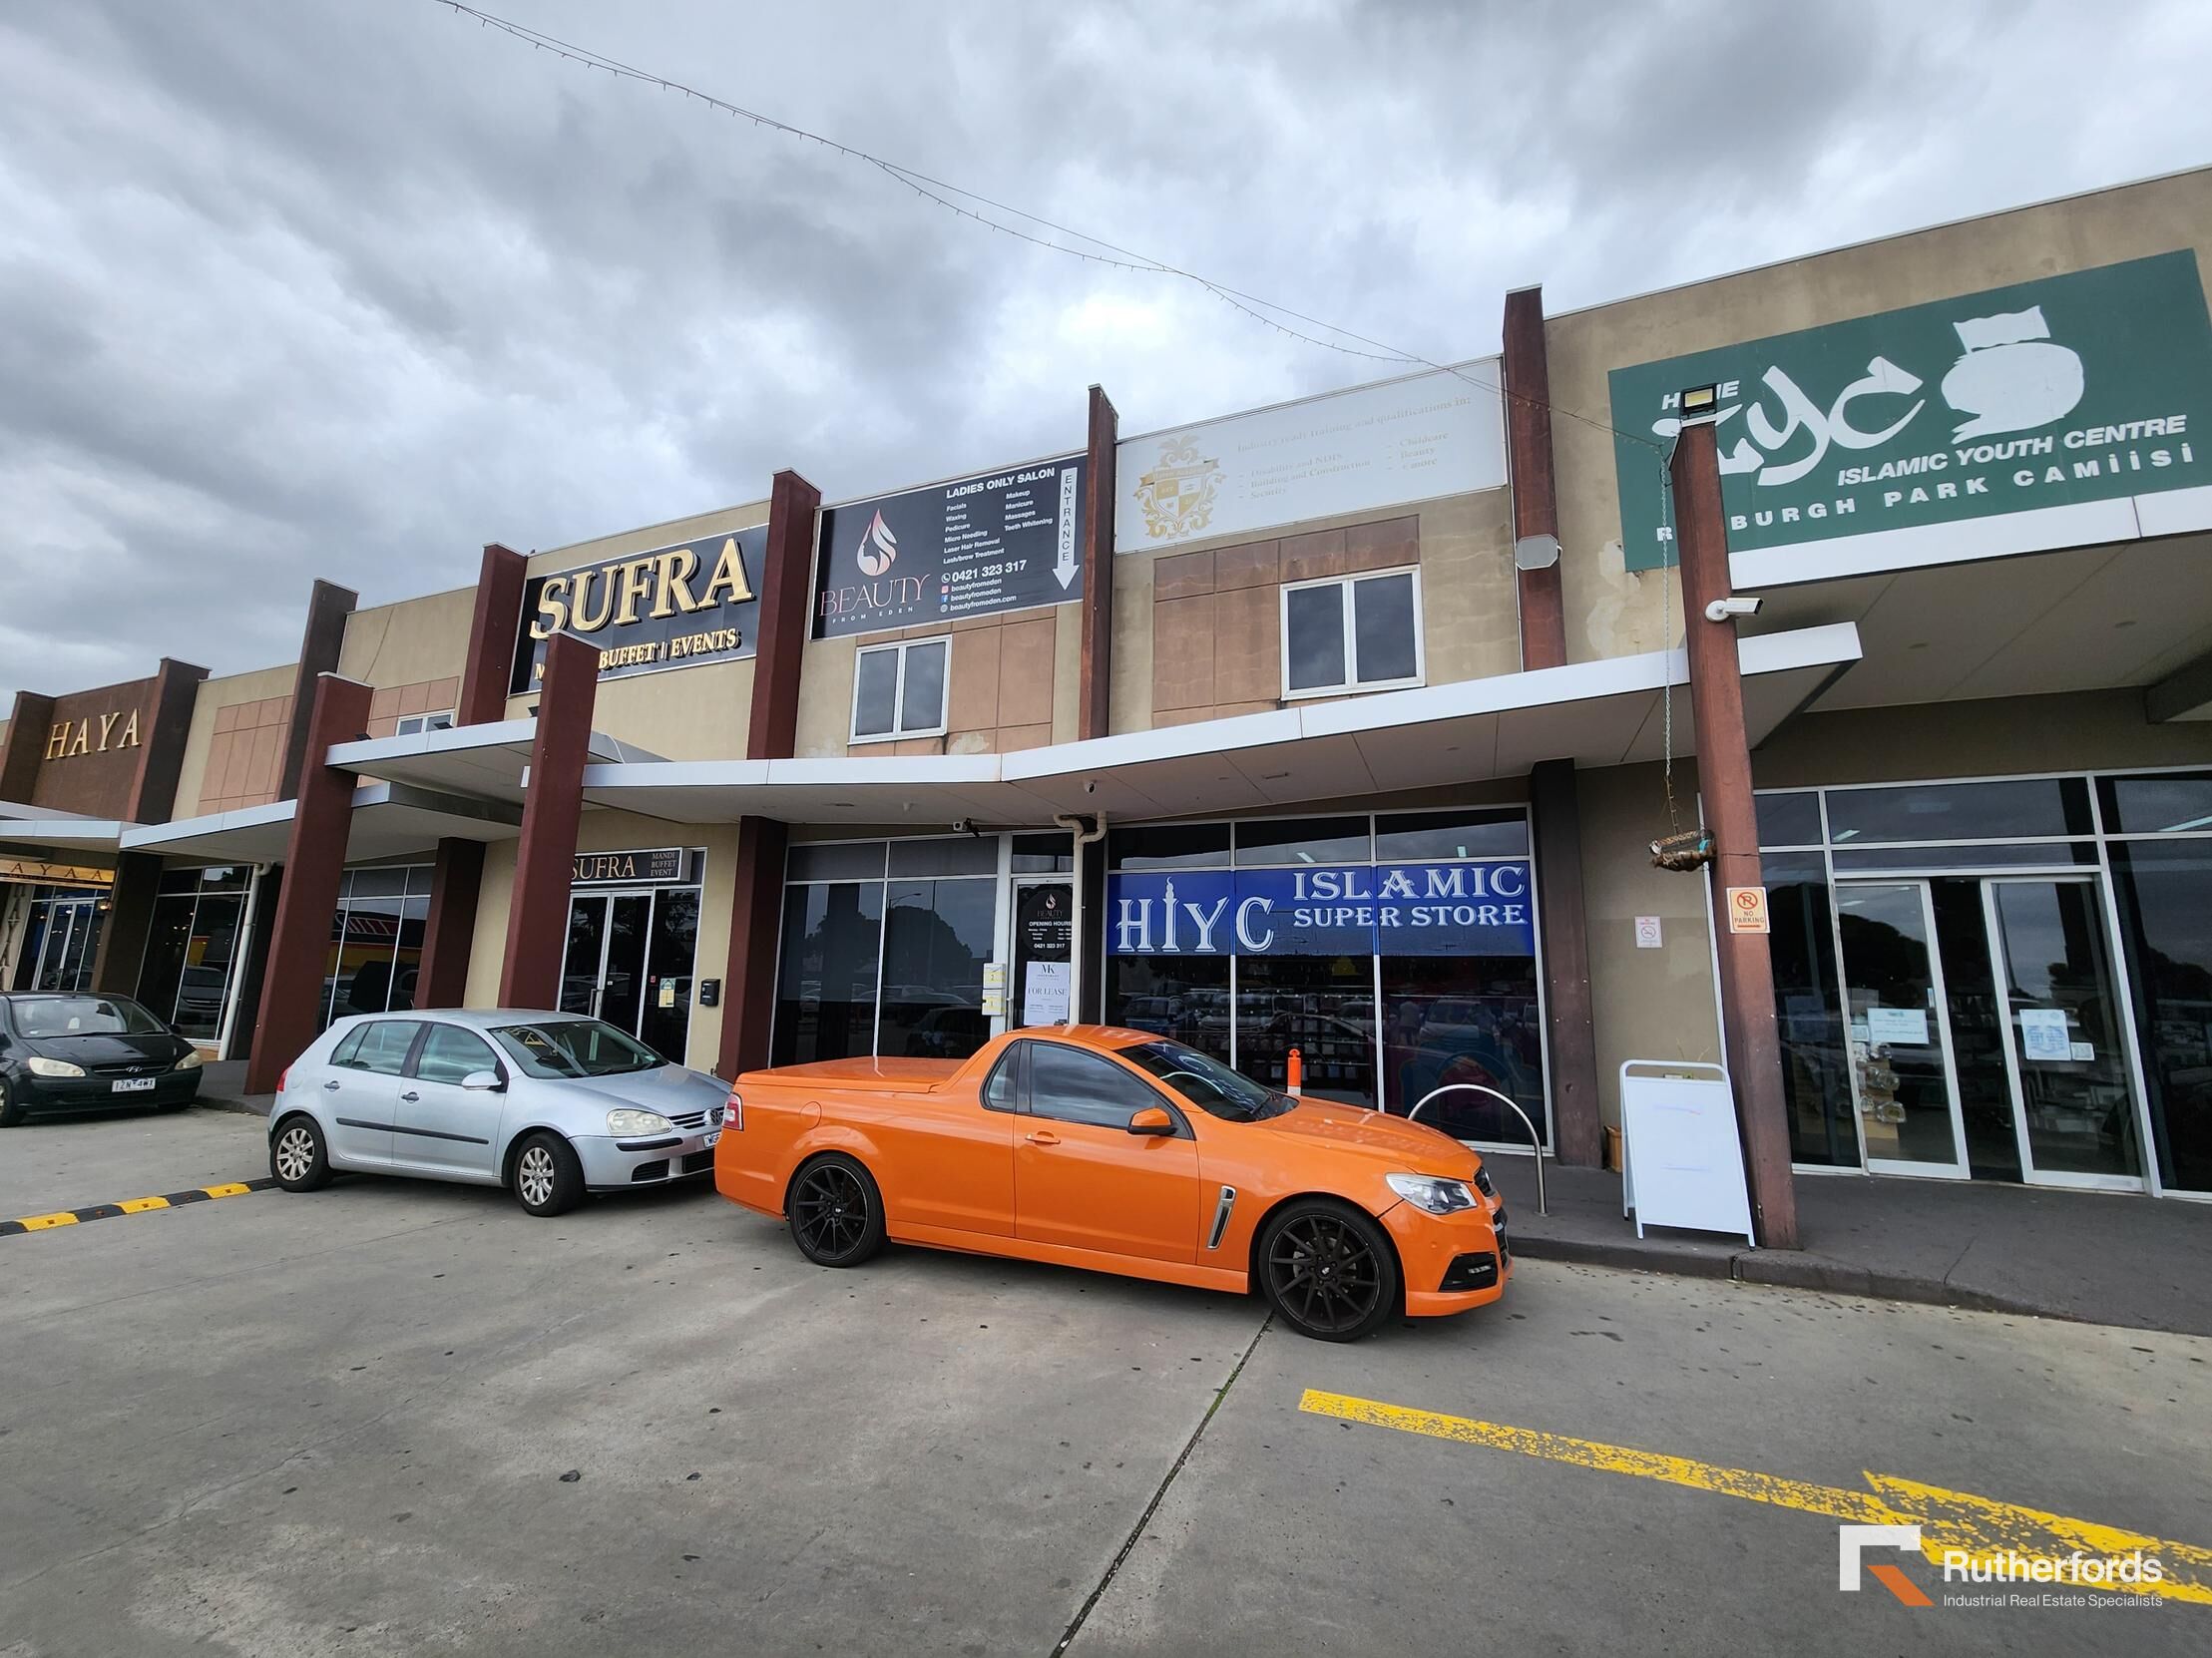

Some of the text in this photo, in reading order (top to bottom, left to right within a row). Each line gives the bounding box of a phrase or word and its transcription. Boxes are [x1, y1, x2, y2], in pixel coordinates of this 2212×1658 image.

[1661, 380, 1740, 410] HE
[1377, 401, 1453, 424] qualifications
[1400, 447, 1435, 459] Beauty
[1837, 415, 2187, 487] ISLAMIC YOUTH CENTRE
[1250, 460, 1371, 489] Building and Construction
[946, 467, 1056, 499] LADIES ONLY SALON
[1006, 490, 1031, 499] Makeup
[1250, 487, 1286, 499] Security
[946, 503, 967, 512] Facials
[1005, 500, 1034, 510] Manicure
[1656, 498, 1855, 542] RBURGH
[1884, 477, 1989, 508] PARK
[946, 514, 967, 523] Waxing
[1005, 511, 1036, 521] Massages
[1062, 475, 1073, 562] ENTRANCE
[945, 523, 971, 533] Pedicure
[1004, 518, 1054, 532] Teeth Whitening
[962, 530, 988, 541] Needling
[961, 542, 973, 551] Hair
[974, 538, 1001, 548] Removal
[975, 548, 1005, 559] Treatment
[952, 560, 1027, 583] 0421 323 317
[529, 537, 756, 640] SUFRA
[951, 579, 1002, 593] beautyfromeden
[819, 574, 931, 617] BEAUTY
[951, 588, 1002, 602] beautyfromeden
[950, 596, 1017, 612] beautyfromeden.com
[832, 607, 913, 623] FROM EDEN
[599, 628, 740, 672] BUFFET EVENTS
[45, 707, 142, 760] HAYA
[10, 862, 103, 880] AYAA
[572, 855, 636, 880] SUFRA
[651, 860, 676, 869] BUFFET
[1293, 865, 1526, 901] ISLAMIC
[1293, 904, 1528, 928] SUPER STORE
[1044, 987, 1068, 997] LEASE
